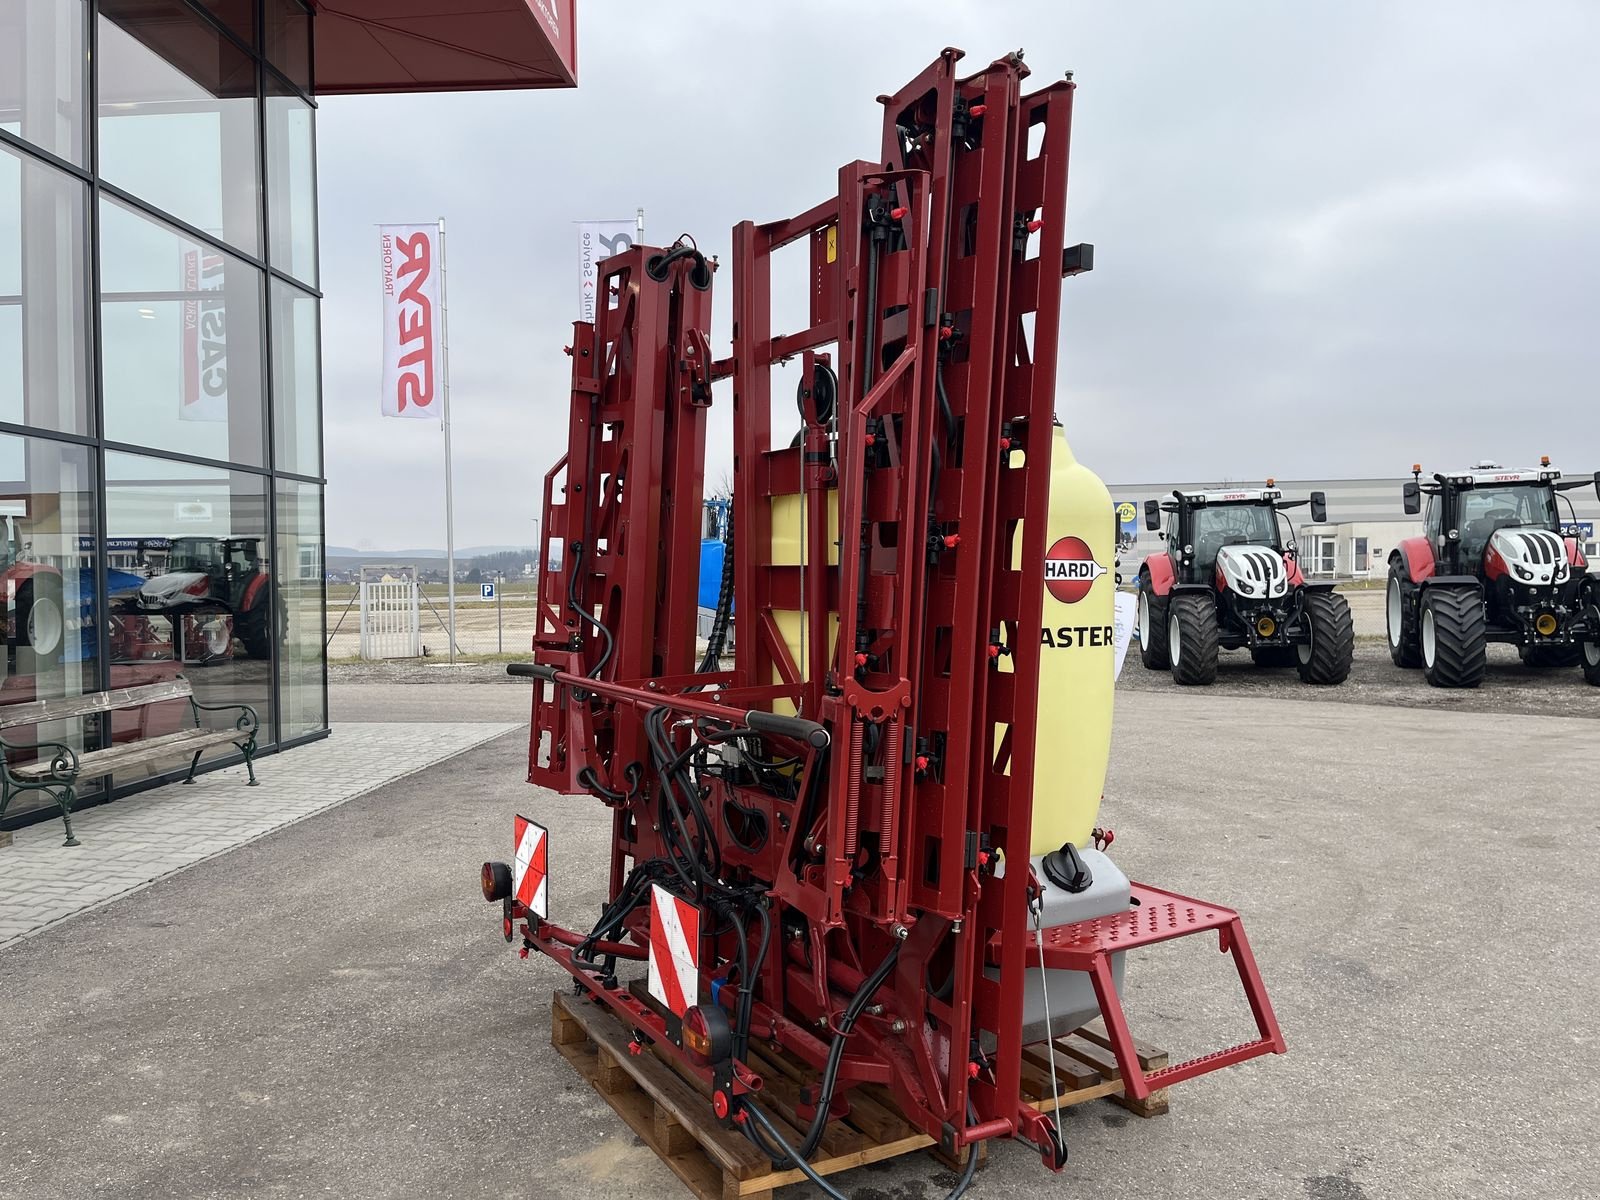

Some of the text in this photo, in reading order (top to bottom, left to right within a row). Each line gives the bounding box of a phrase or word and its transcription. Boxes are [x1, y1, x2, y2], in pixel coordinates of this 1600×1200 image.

[1045, 562, 1094, 578] HARDI
[484, 585, 492, 596] P
[1040, 626, 1113, 648] ASTER
